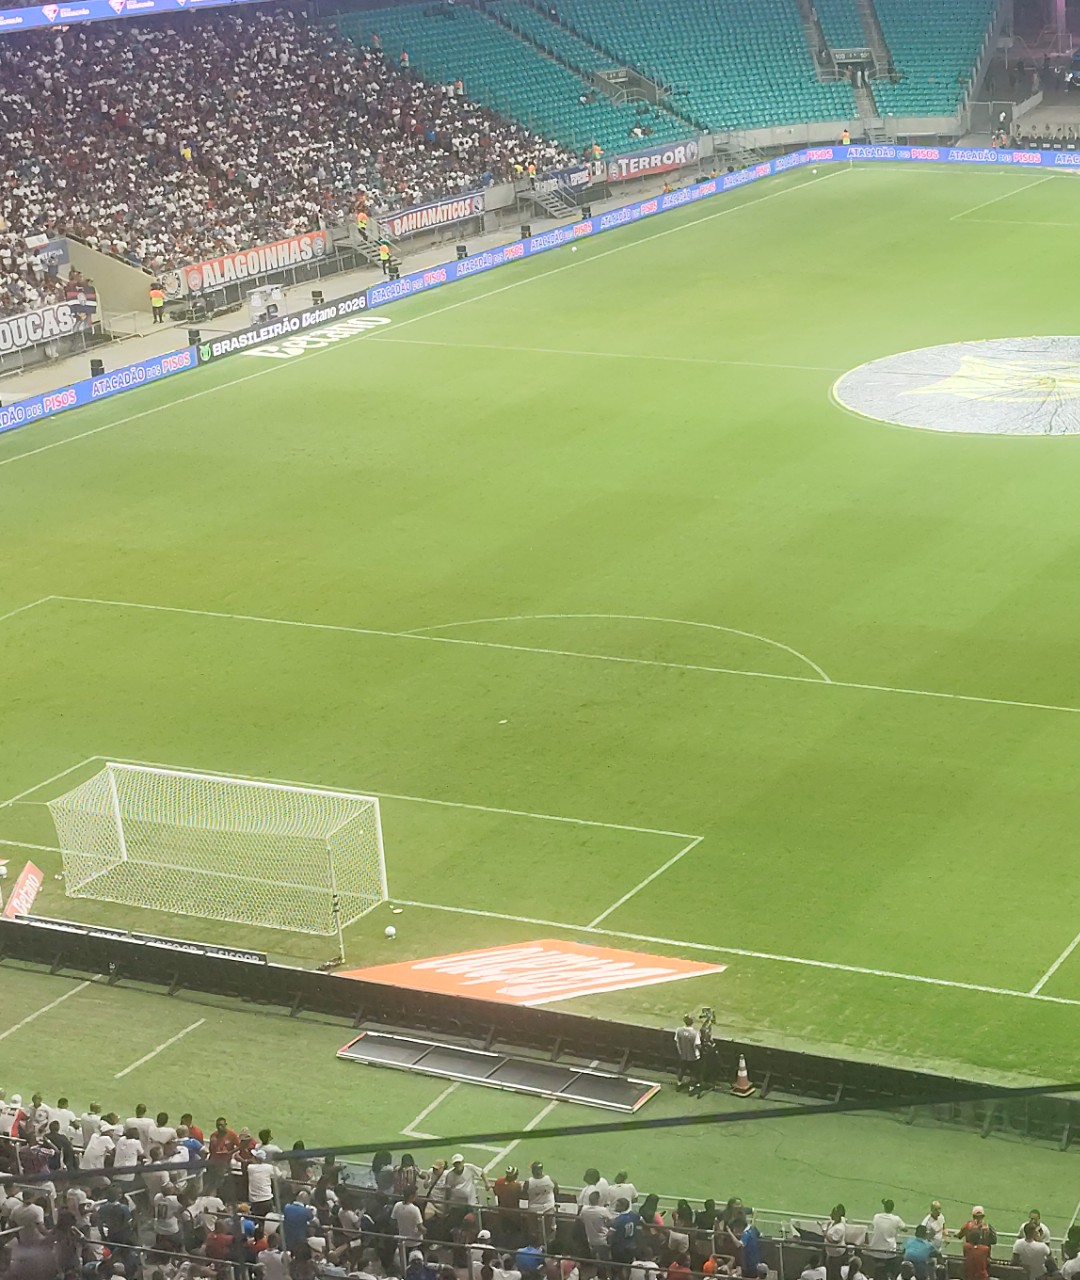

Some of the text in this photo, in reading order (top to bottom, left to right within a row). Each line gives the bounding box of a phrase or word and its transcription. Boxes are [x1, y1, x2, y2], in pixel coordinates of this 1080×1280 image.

[617, 146, 687, 177] TERROR
[807, 149, 833, 160] PISOS
[848, 147, 895, 158] ATACADÃO
[912, 149, 940, 160] PISOS
[948, 149, 997, 161] ATACADÃO
[1012, 152, 1041, 163] PISOS
[700, 181, 716, 196] PISOS
[640, 200, 658, 216] PISOS
[572, 222, 592, 236] PISOS
[202, 236, 313, 286] ALAGOINHAS
[456, 252, 494, 276] ATACADÃO
[503, 243, 524, 260] PISOS
[371, 278, 411, 306] ATACADÃO
[423, 268, 447, 287] PISOS
[212, 296, 366, 357] BRASILEIRÃO Betano 2026
[92, 366, 146, 398] ATACADÃO
[162, 351, 191, 374] PISOS
[43, 389, 77, 412] PISOS
[12, 873, 40, 914] Betano
